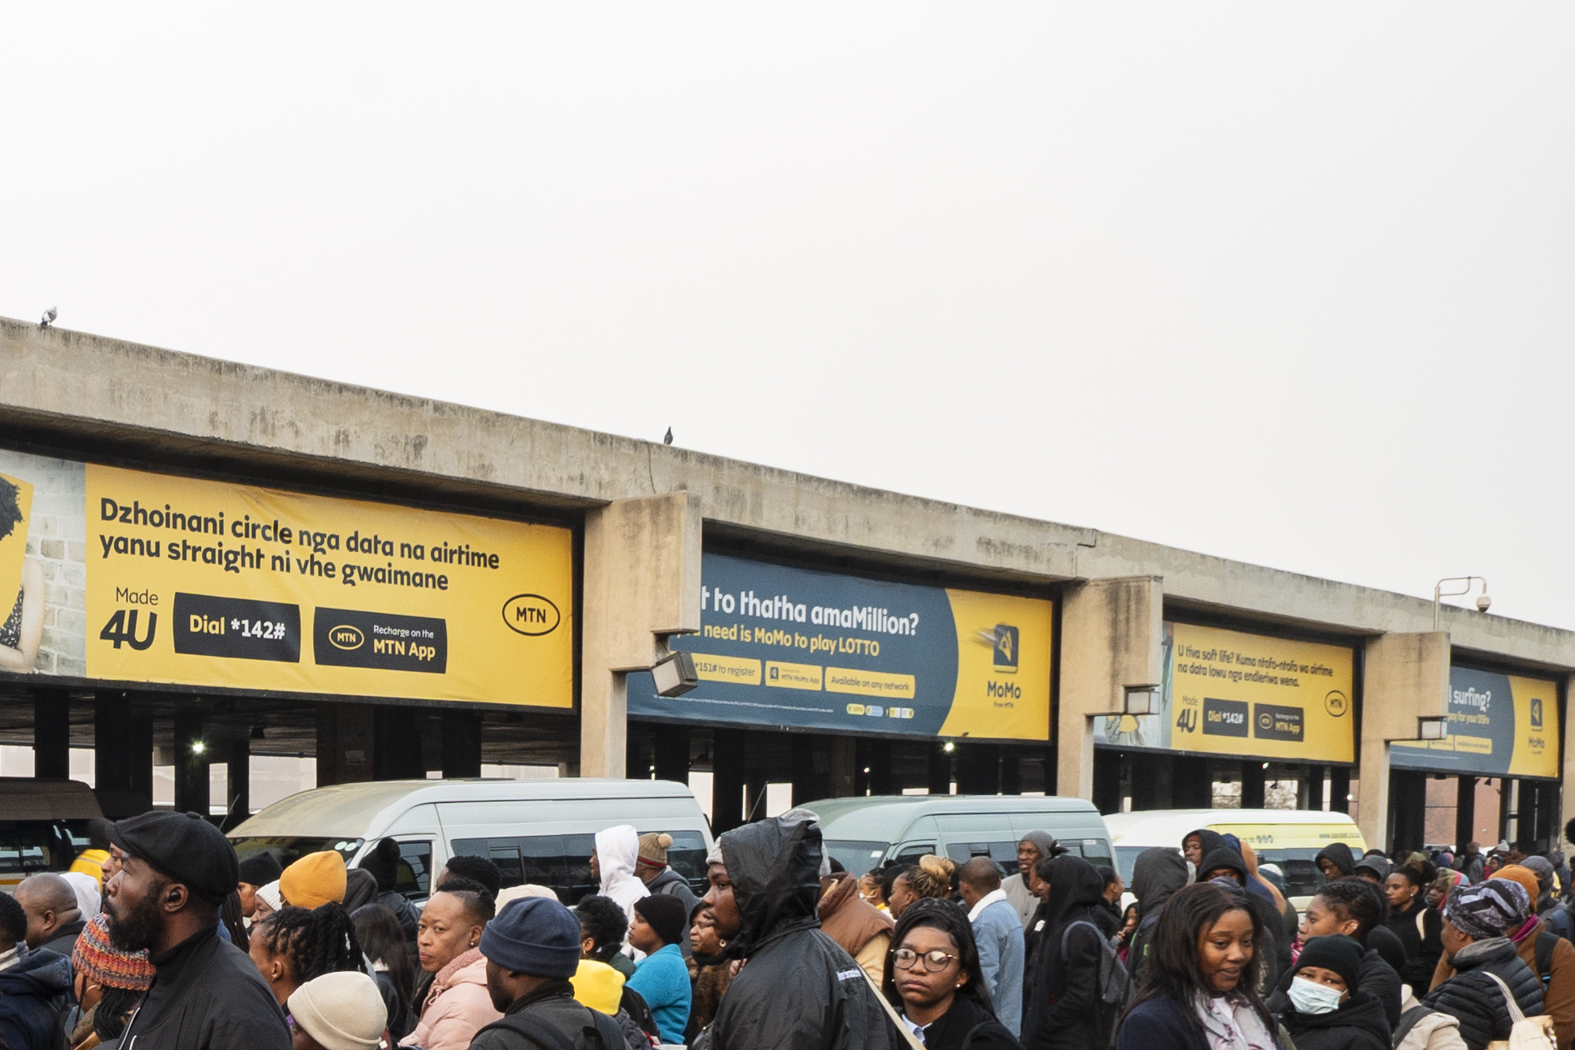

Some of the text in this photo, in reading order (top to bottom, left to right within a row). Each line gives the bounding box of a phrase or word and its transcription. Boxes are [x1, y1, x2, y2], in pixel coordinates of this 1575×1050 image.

[100, 498, 499, 570] Dzhoinani circle nga data na airtime
[100, 532, 448, 590] yanu straight ni vhe gwaimane
[116, 586, 159, 606] Made
[516, 606, 547, 624] MTN
[714, 587, 735, 613] to
[740, 591, 806, 622] thatha
[811, 606, 919, 636] amaMillion?
[100, 609, 158, 651] 4U
[189, 614, 225, 635] Dial
[374, 624, 435, 639] Recharge on the
[337, 632, 357, 644] MTN
[704, 623, 737, 640] need
[740, 625, 752, 642] is
[754, 627, 792, 647] MoMo
[794, 632, 808, 648] to
[810, 634, 836, 655] play
[839, 637, 880, 656] LOTTO
[374, 640, 436, 661] MTN App
[1178, 644, 1184, 656] U
[1202, 649, 1218, 662] soft
[1219, 650, 1234, 664] life?
[1236, 653, 1256, 667] Kuma
[1299, 663, 1309, 673] wa
[1310, 663, 1333, 677] airtime
[718, 664, 726, 675] to
[727, 666, 755, 679] register
[1177, 662, 1187, 673] na
[1189, 662, 1207, 676] data
[1228, 669, 1242, 683] nga
[831, 675, 910, 692] Available on any network
[987, 680, 1021, 699] MoMo
[1453, 687, 1491, 713] surfing?
[1176, 708, 1197, 733] 4U
